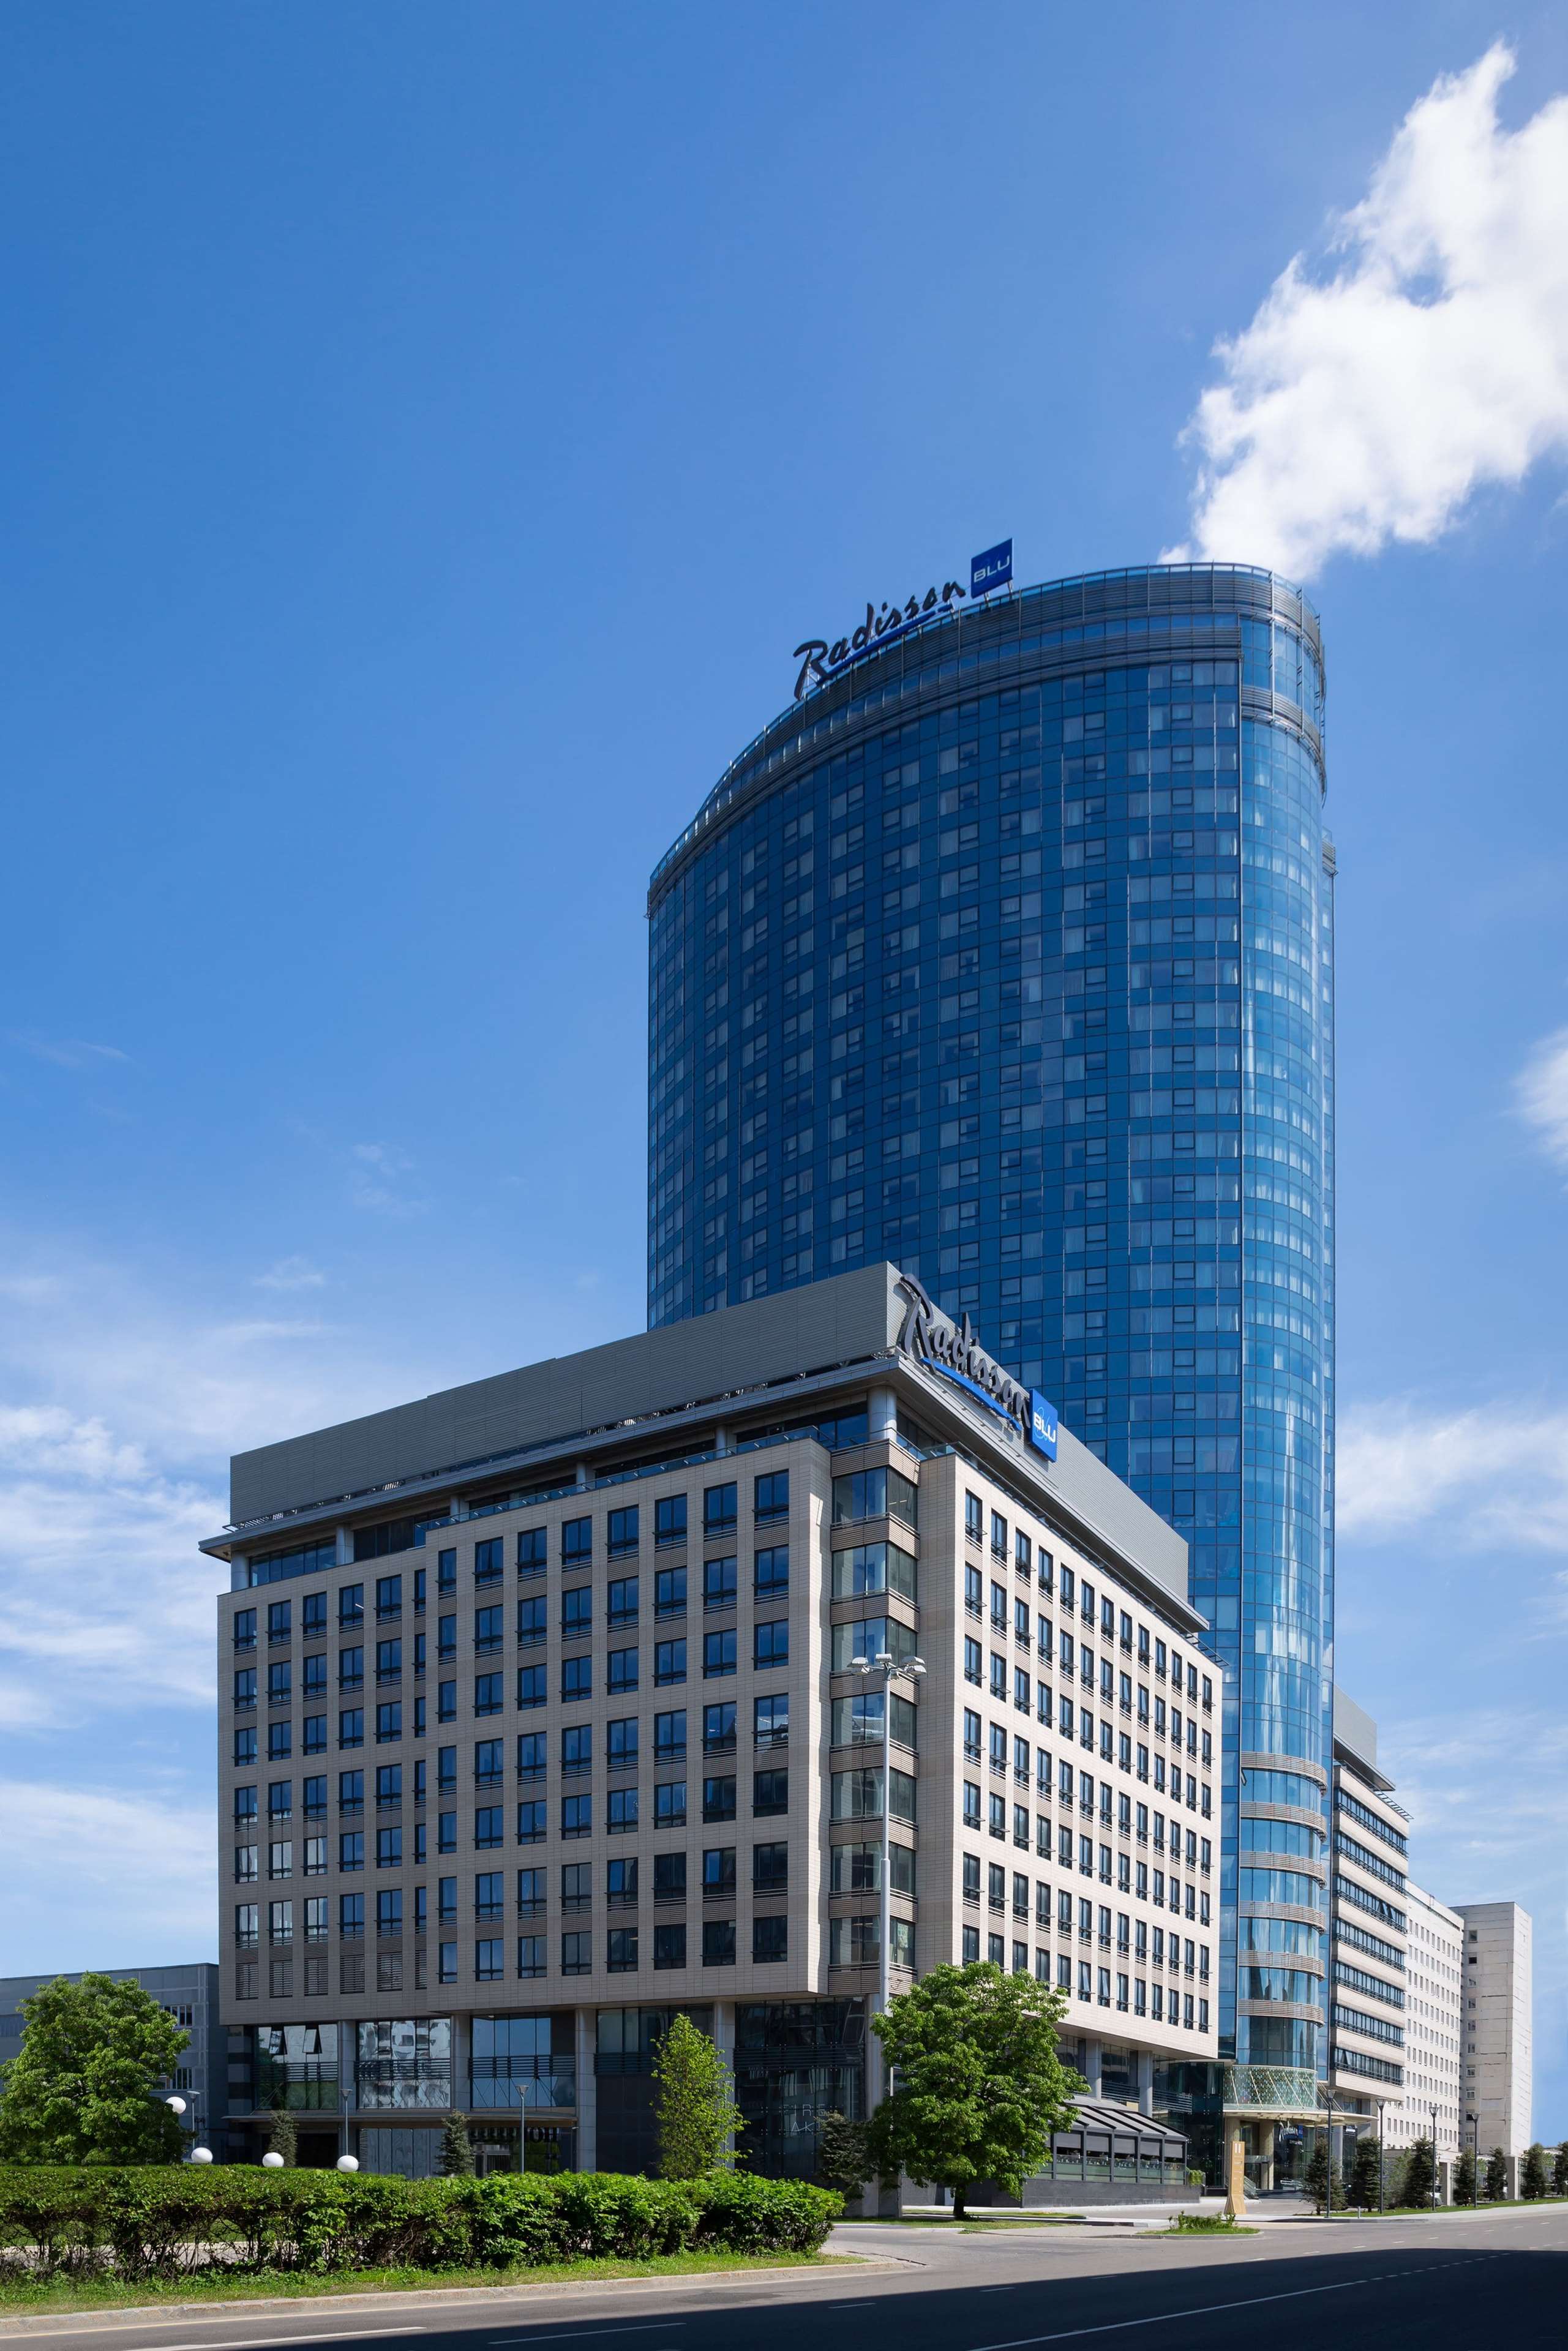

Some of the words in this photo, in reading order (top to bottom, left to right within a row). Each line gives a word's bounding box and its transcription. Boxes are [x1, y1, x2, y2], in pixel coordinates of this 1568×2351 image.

[793, 581, 966, 700] Radisson
[974, 555, 1010, 582] BLU
[899, 1273, 1031, 1428] Radisson
[1033, 1411, 1056, 1442] BLU
